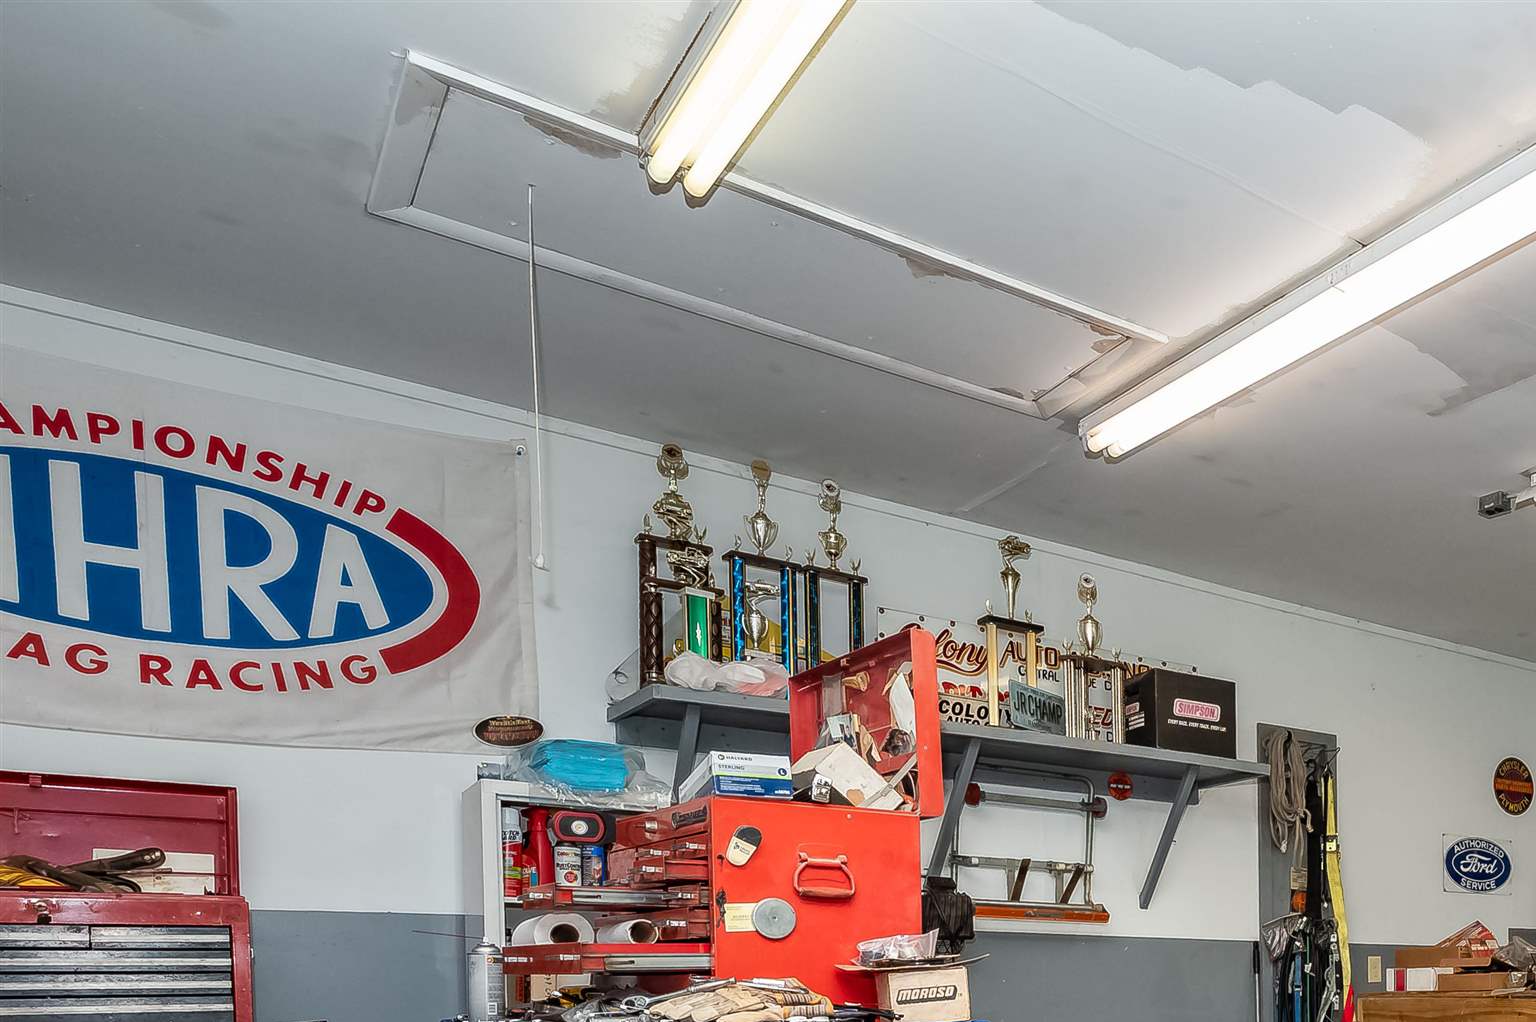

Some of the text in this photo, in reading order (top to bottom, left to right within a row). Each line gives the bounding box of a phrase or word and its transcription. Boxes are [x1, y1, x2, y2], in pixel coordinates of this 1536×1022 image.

[138, 653, 379, 693] RACING
[1028, 694, 1063, 726] CHAMP
[1177, 702, 1216, 719] SIMPSON
[1499, 760, 1529, 779] CHRYSLER
[1498, 792, 1530, 813] PLYMOUTH
[1453, 839, 1506, 860] AUTHORIZED
[1459, 853, 1499, 875] Ford
[1459, 876, 1497, 891] SERVICE
[896, 984, 959, 1005] MOROSO
